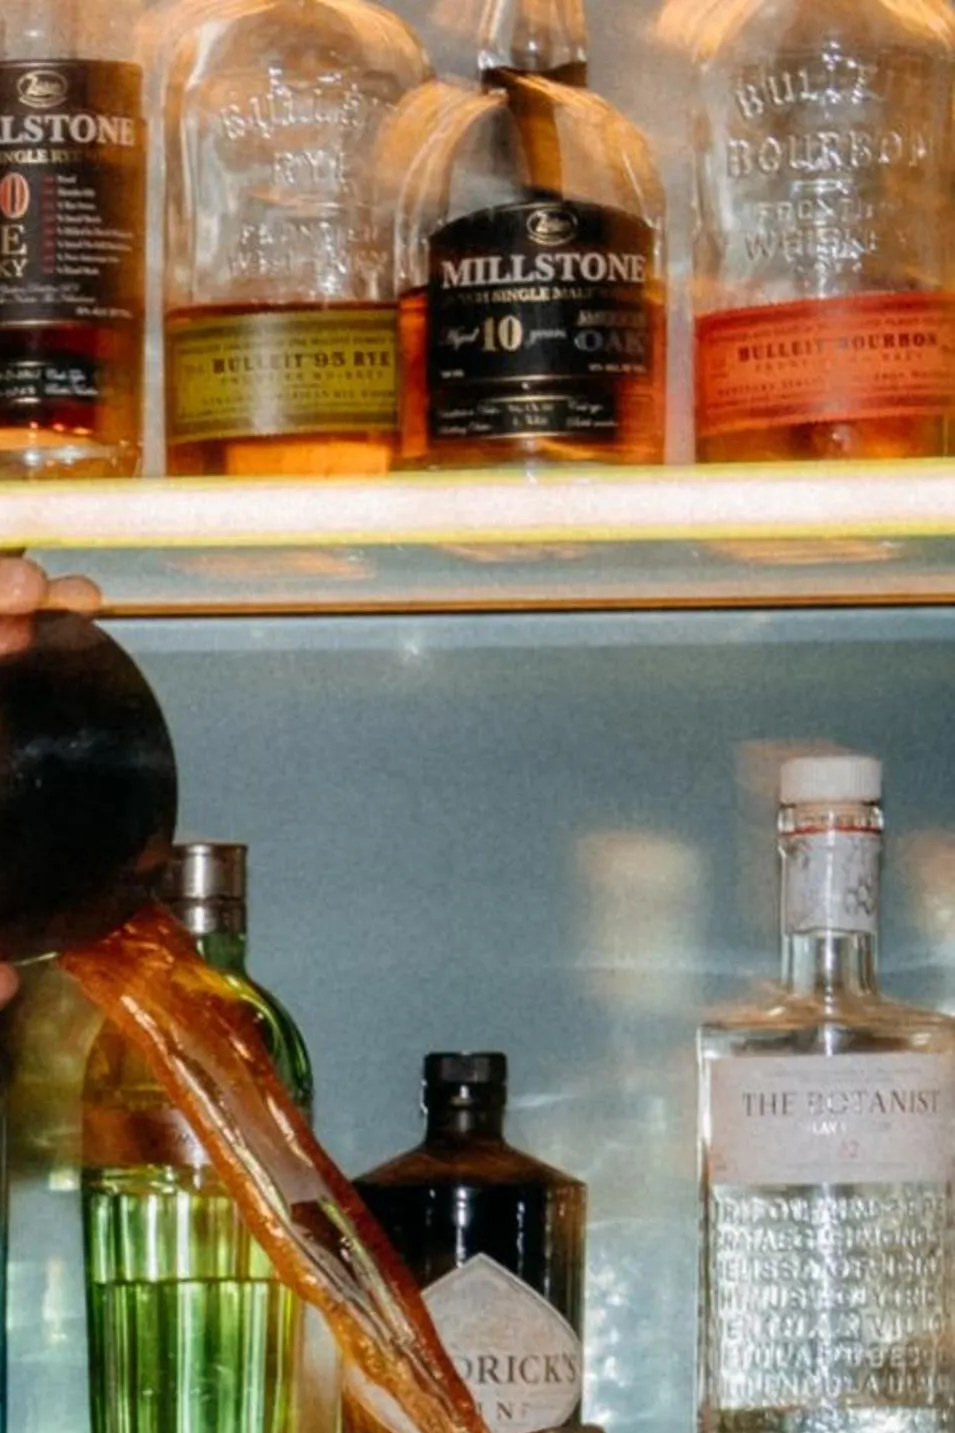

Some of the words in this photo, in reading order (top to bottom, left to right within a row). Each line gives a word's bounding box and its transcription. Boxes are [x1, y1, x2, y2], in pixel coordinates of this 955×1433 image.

[440, 252, 647, 290] MILLSTONE
[482, 315, 524, 352] 10
[737, 338, 825, 363] BULLEIT
[837, 331, 937, 353] BOURBON
[352, 350, 391, 367] RYE
[742, 1091, 796, 1117] THE
[806, 1089, 941, 1116] BOTANIST
[456, 1351, 578, 1385] DRICK'S
